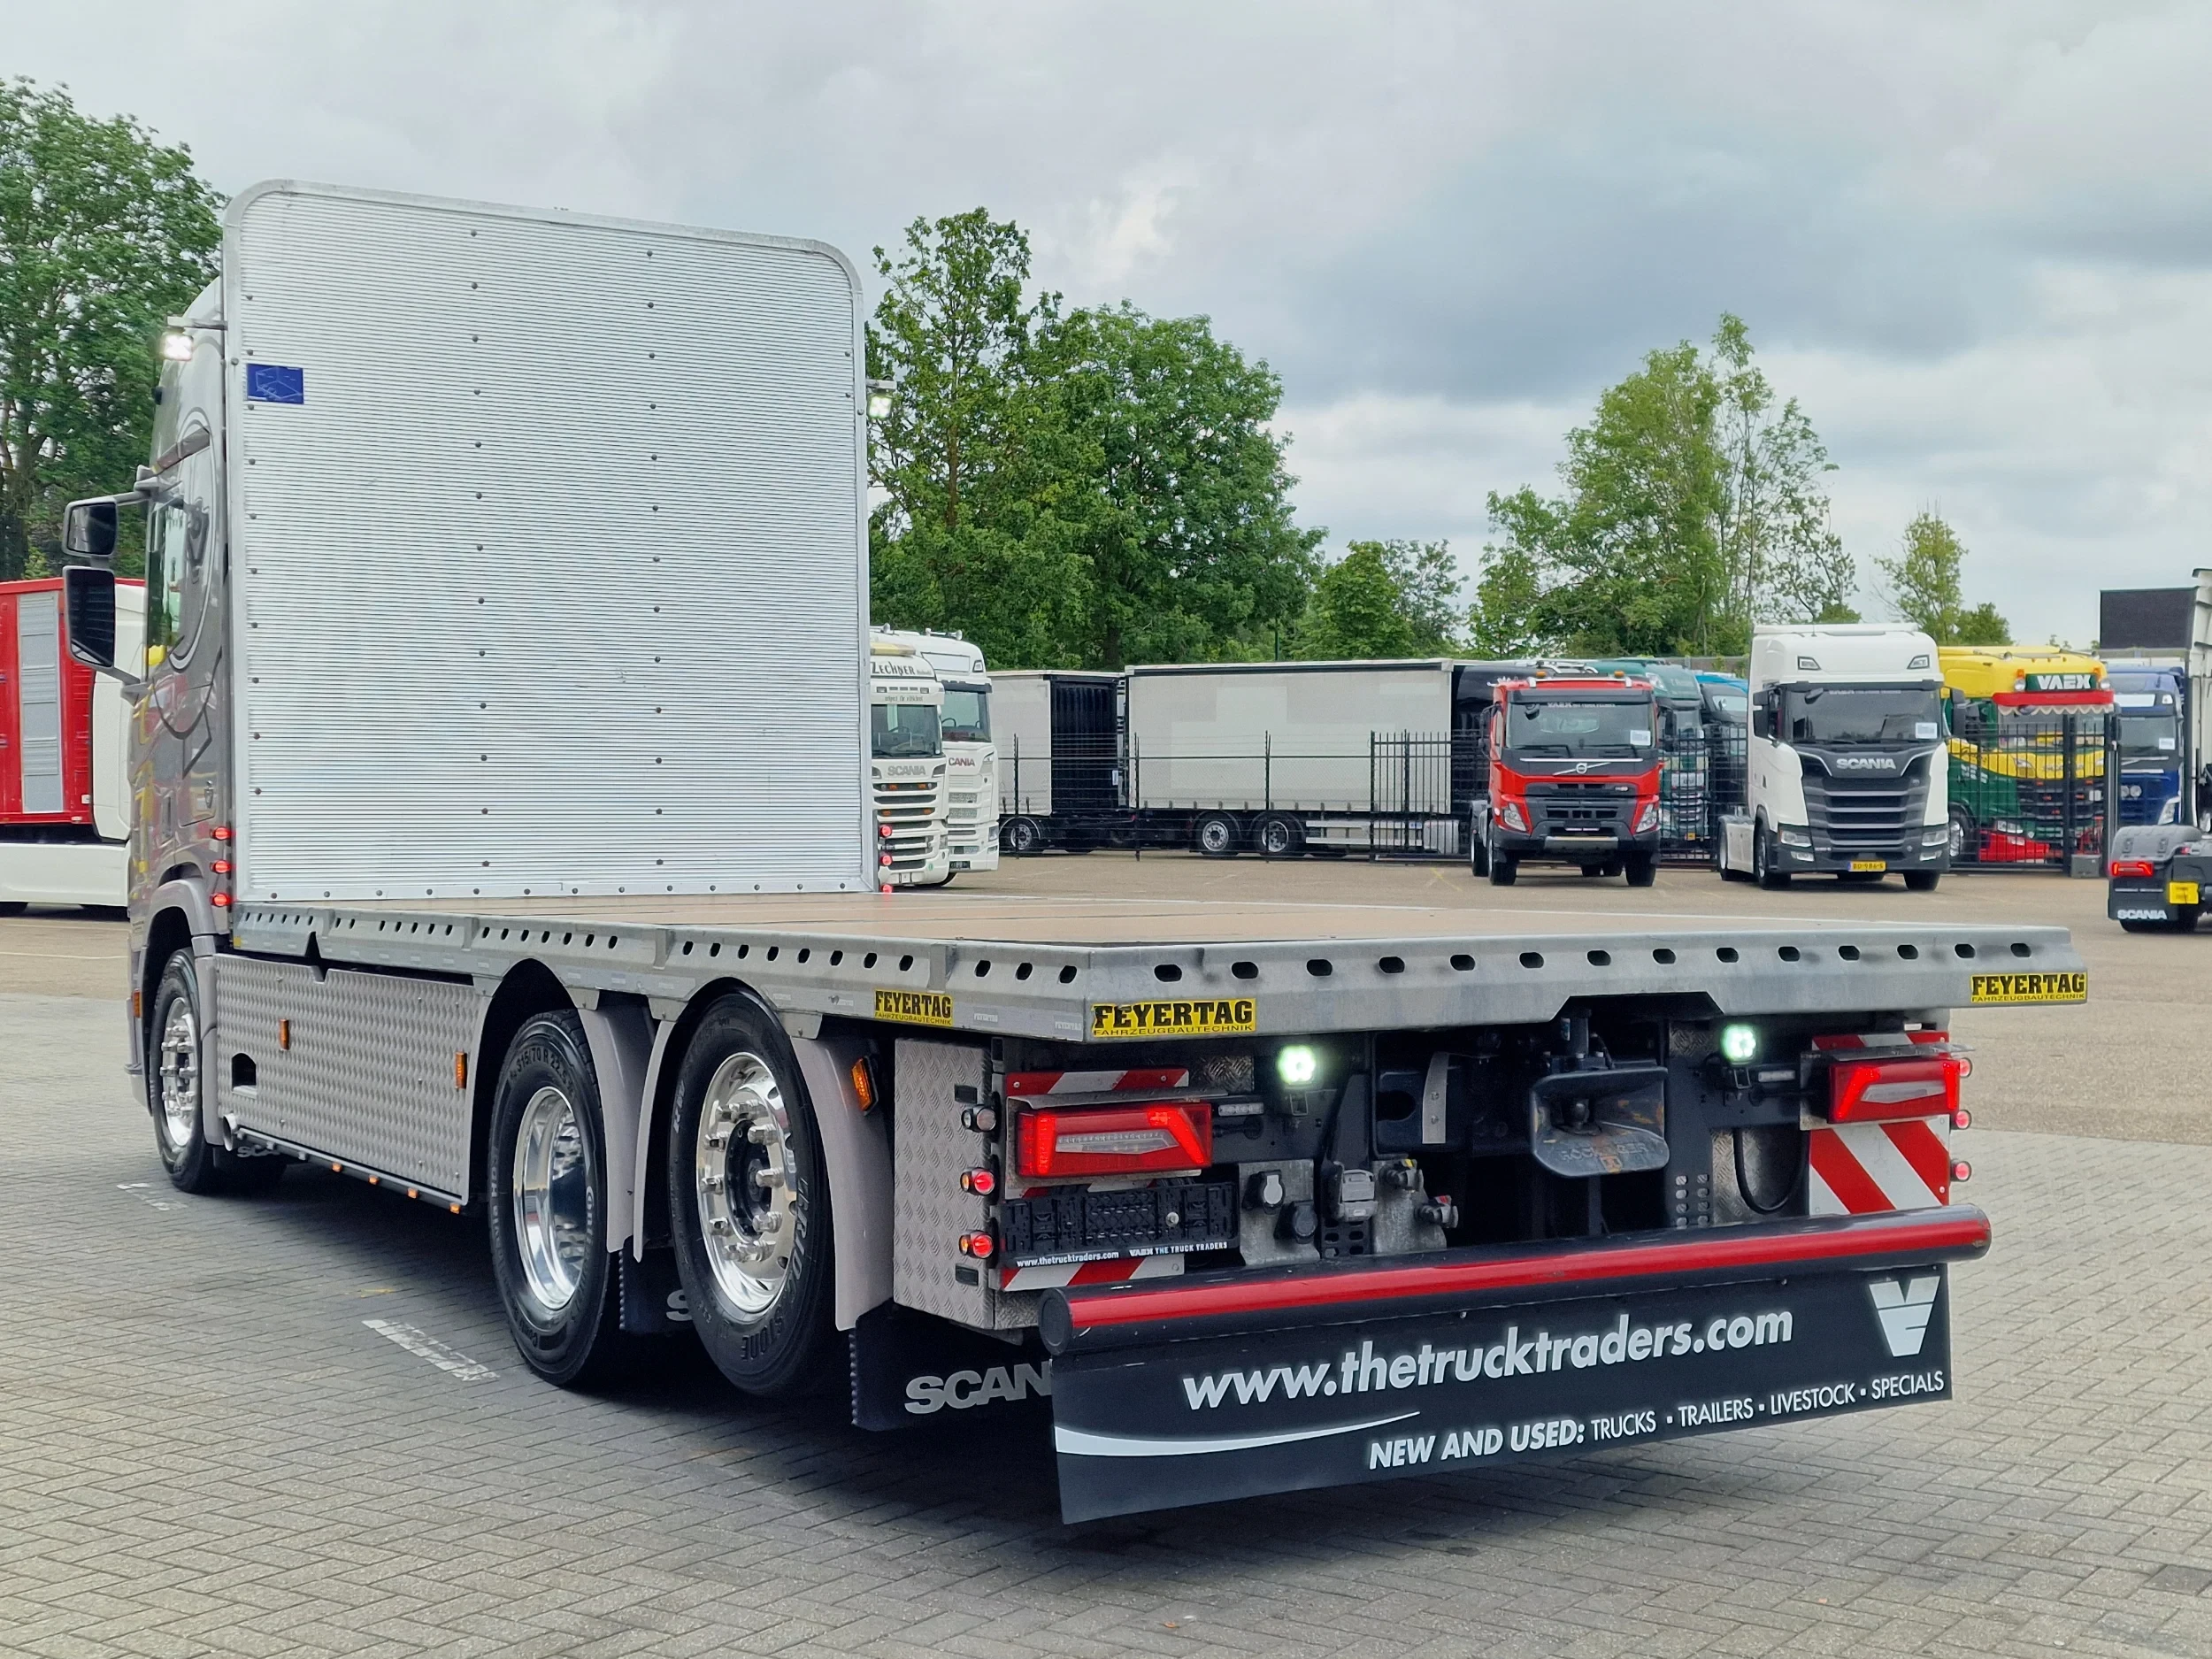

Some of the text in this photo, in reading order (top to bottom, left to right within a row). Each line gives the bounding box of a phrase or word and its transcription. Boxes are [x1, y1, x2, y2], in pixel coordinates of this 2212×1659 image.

[2037, 674, 2091, 689] VAEX
[949, 757, 975, 766] CANIA
[1836, 758, 1896, 770] SCANIA
[887, 765, 926, 776] SCANIA
[2117, 909, 2168, 920] SCANIA
[1971, 973, 2085, 996] FEYERTAG
[875, 990, 951, 1018] FEYERTAG
[1971, 993, 2085, 1002] FAHRZEUGBAUTECHNIK
[874, 1011, 952, 1025] FAHRZEUGBAUTECHNIK
[1094, 1001, 1253, 1028] FEYERTAG
[1094, 1025, 1253, 1036] FAHRZEUGBAUTECHNIK
[1017, 1251, 1119, 1267] www.thetrucktraders.com
[1155, 1246, 1170, 1255] THE
[1171, 1243, 1194, 1254] TRUCK
[1196, 1241, 1228, 1252] TRADERS
[1183, 1310, 1793, 1410] www.thetrucktraders.com
[904, 1360, 1052, 1415] SCAN
[1369, 1371, 1945, 1470] NEW AND USED: TRUCKS TRAILERS LIVESTOCK SPECIALS
